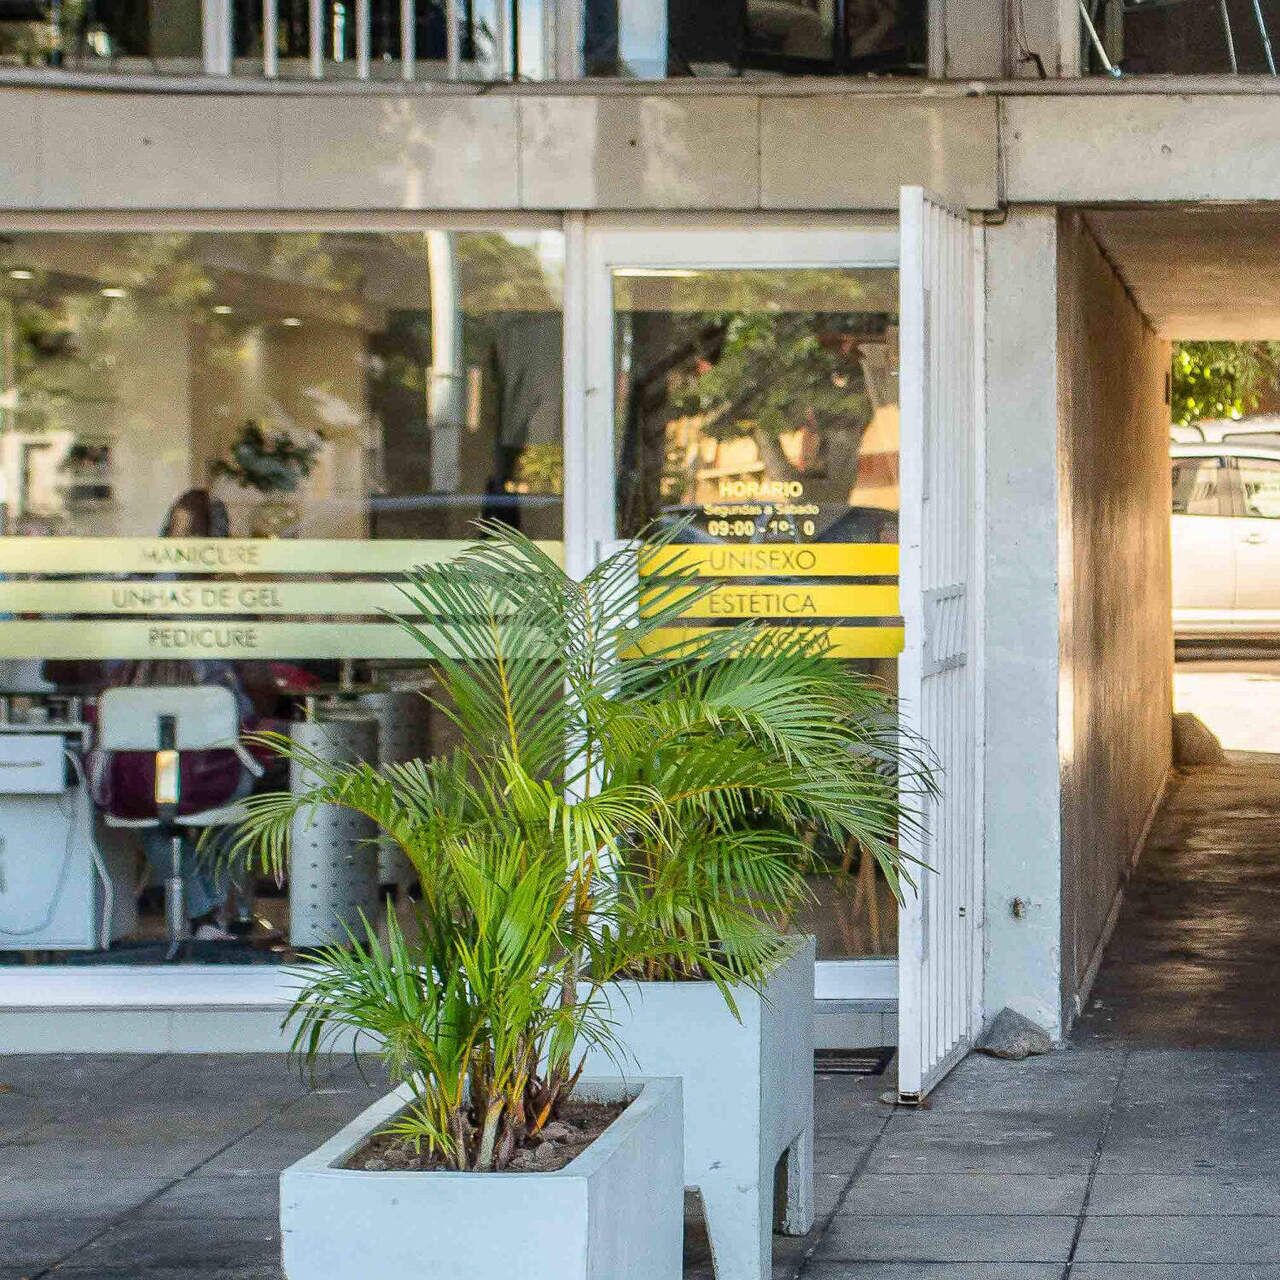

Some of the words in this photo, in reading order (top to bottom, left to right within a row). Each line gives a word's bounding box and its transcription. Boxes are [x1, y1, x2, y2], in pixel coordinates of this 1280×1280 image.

[708, 520, 755, 536] 09:00
[143, 543, 260, 566] MANICURE
[709, 549, 817, 570] UNISEXO
[111, 588, 194, 609] UNHAS
[201, 589, 234, 608] DE
[238, 588, 283, 609] GEL
[709, 589, 818, 614] ESTÉTICA
[149, 627, 259, 649] PEDICURE
